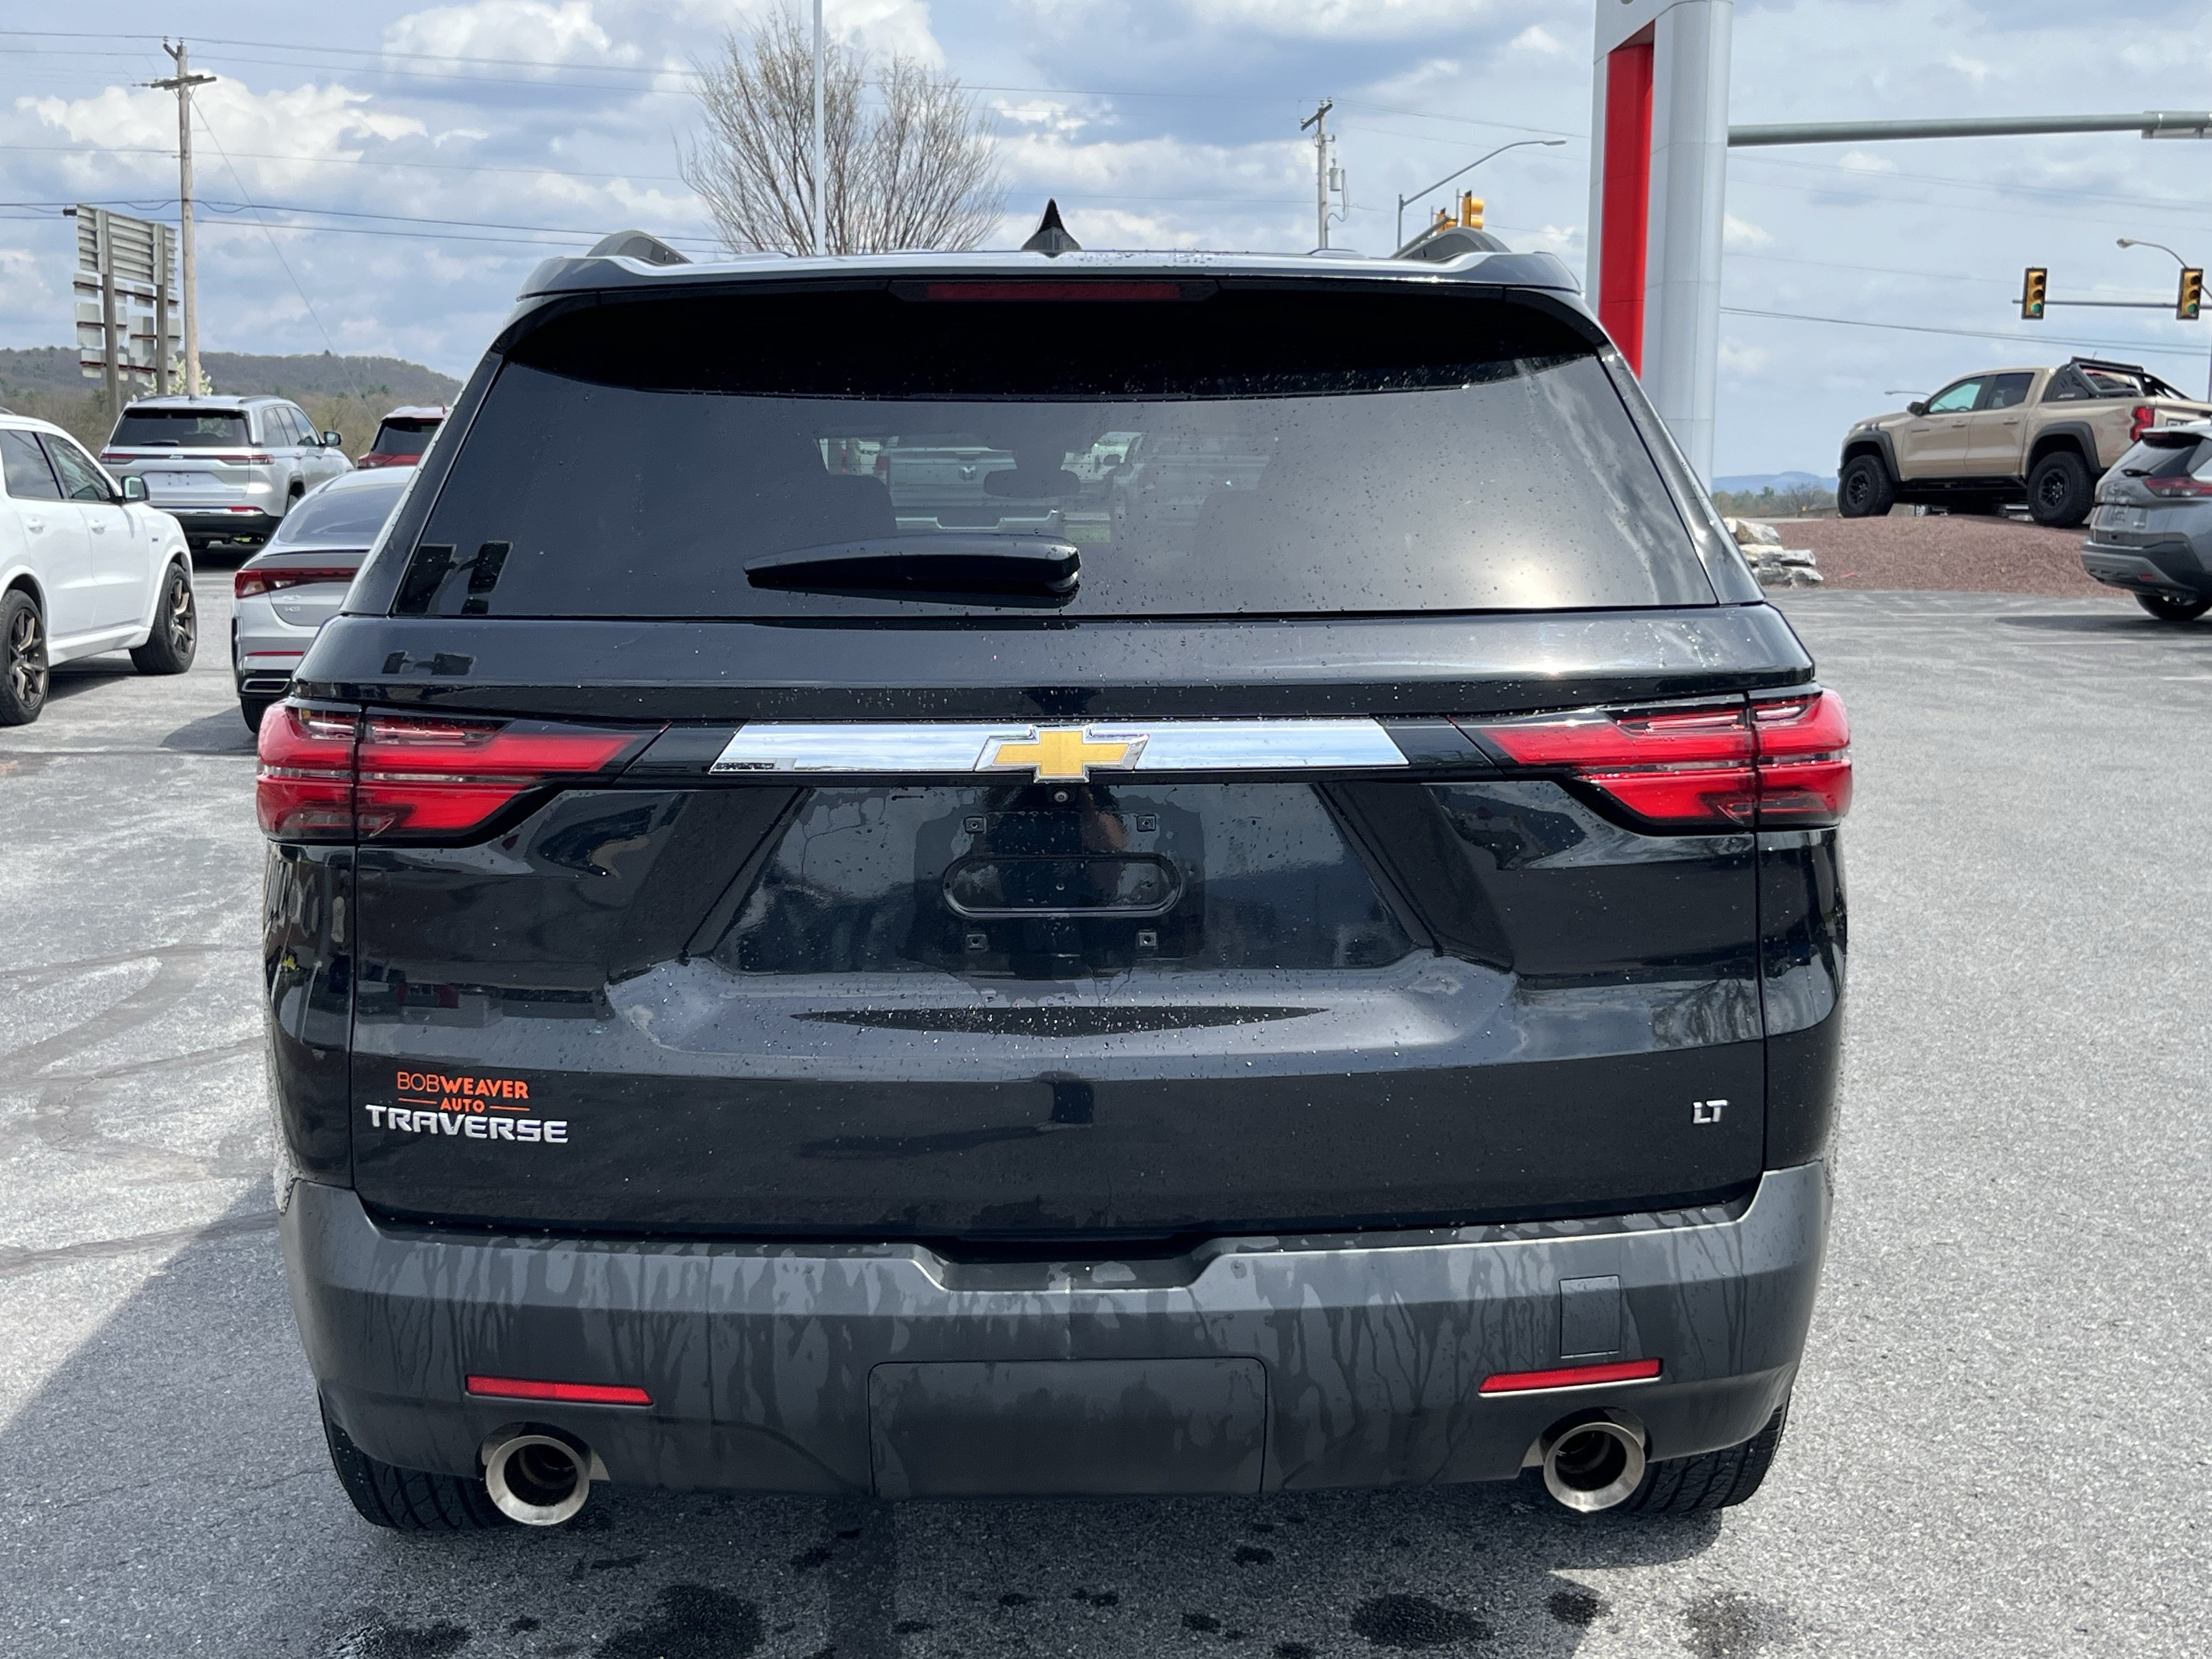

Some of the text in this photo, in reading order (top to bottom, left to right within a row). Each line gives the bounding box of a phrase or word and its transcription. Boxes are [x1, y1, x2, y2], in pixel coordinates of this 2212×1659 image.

[440, 1097, 486, 1113] AUTO
[1692, 1099, 1728, 1124] LT
[365, 1104, 569, 1143] TRAVERSE
